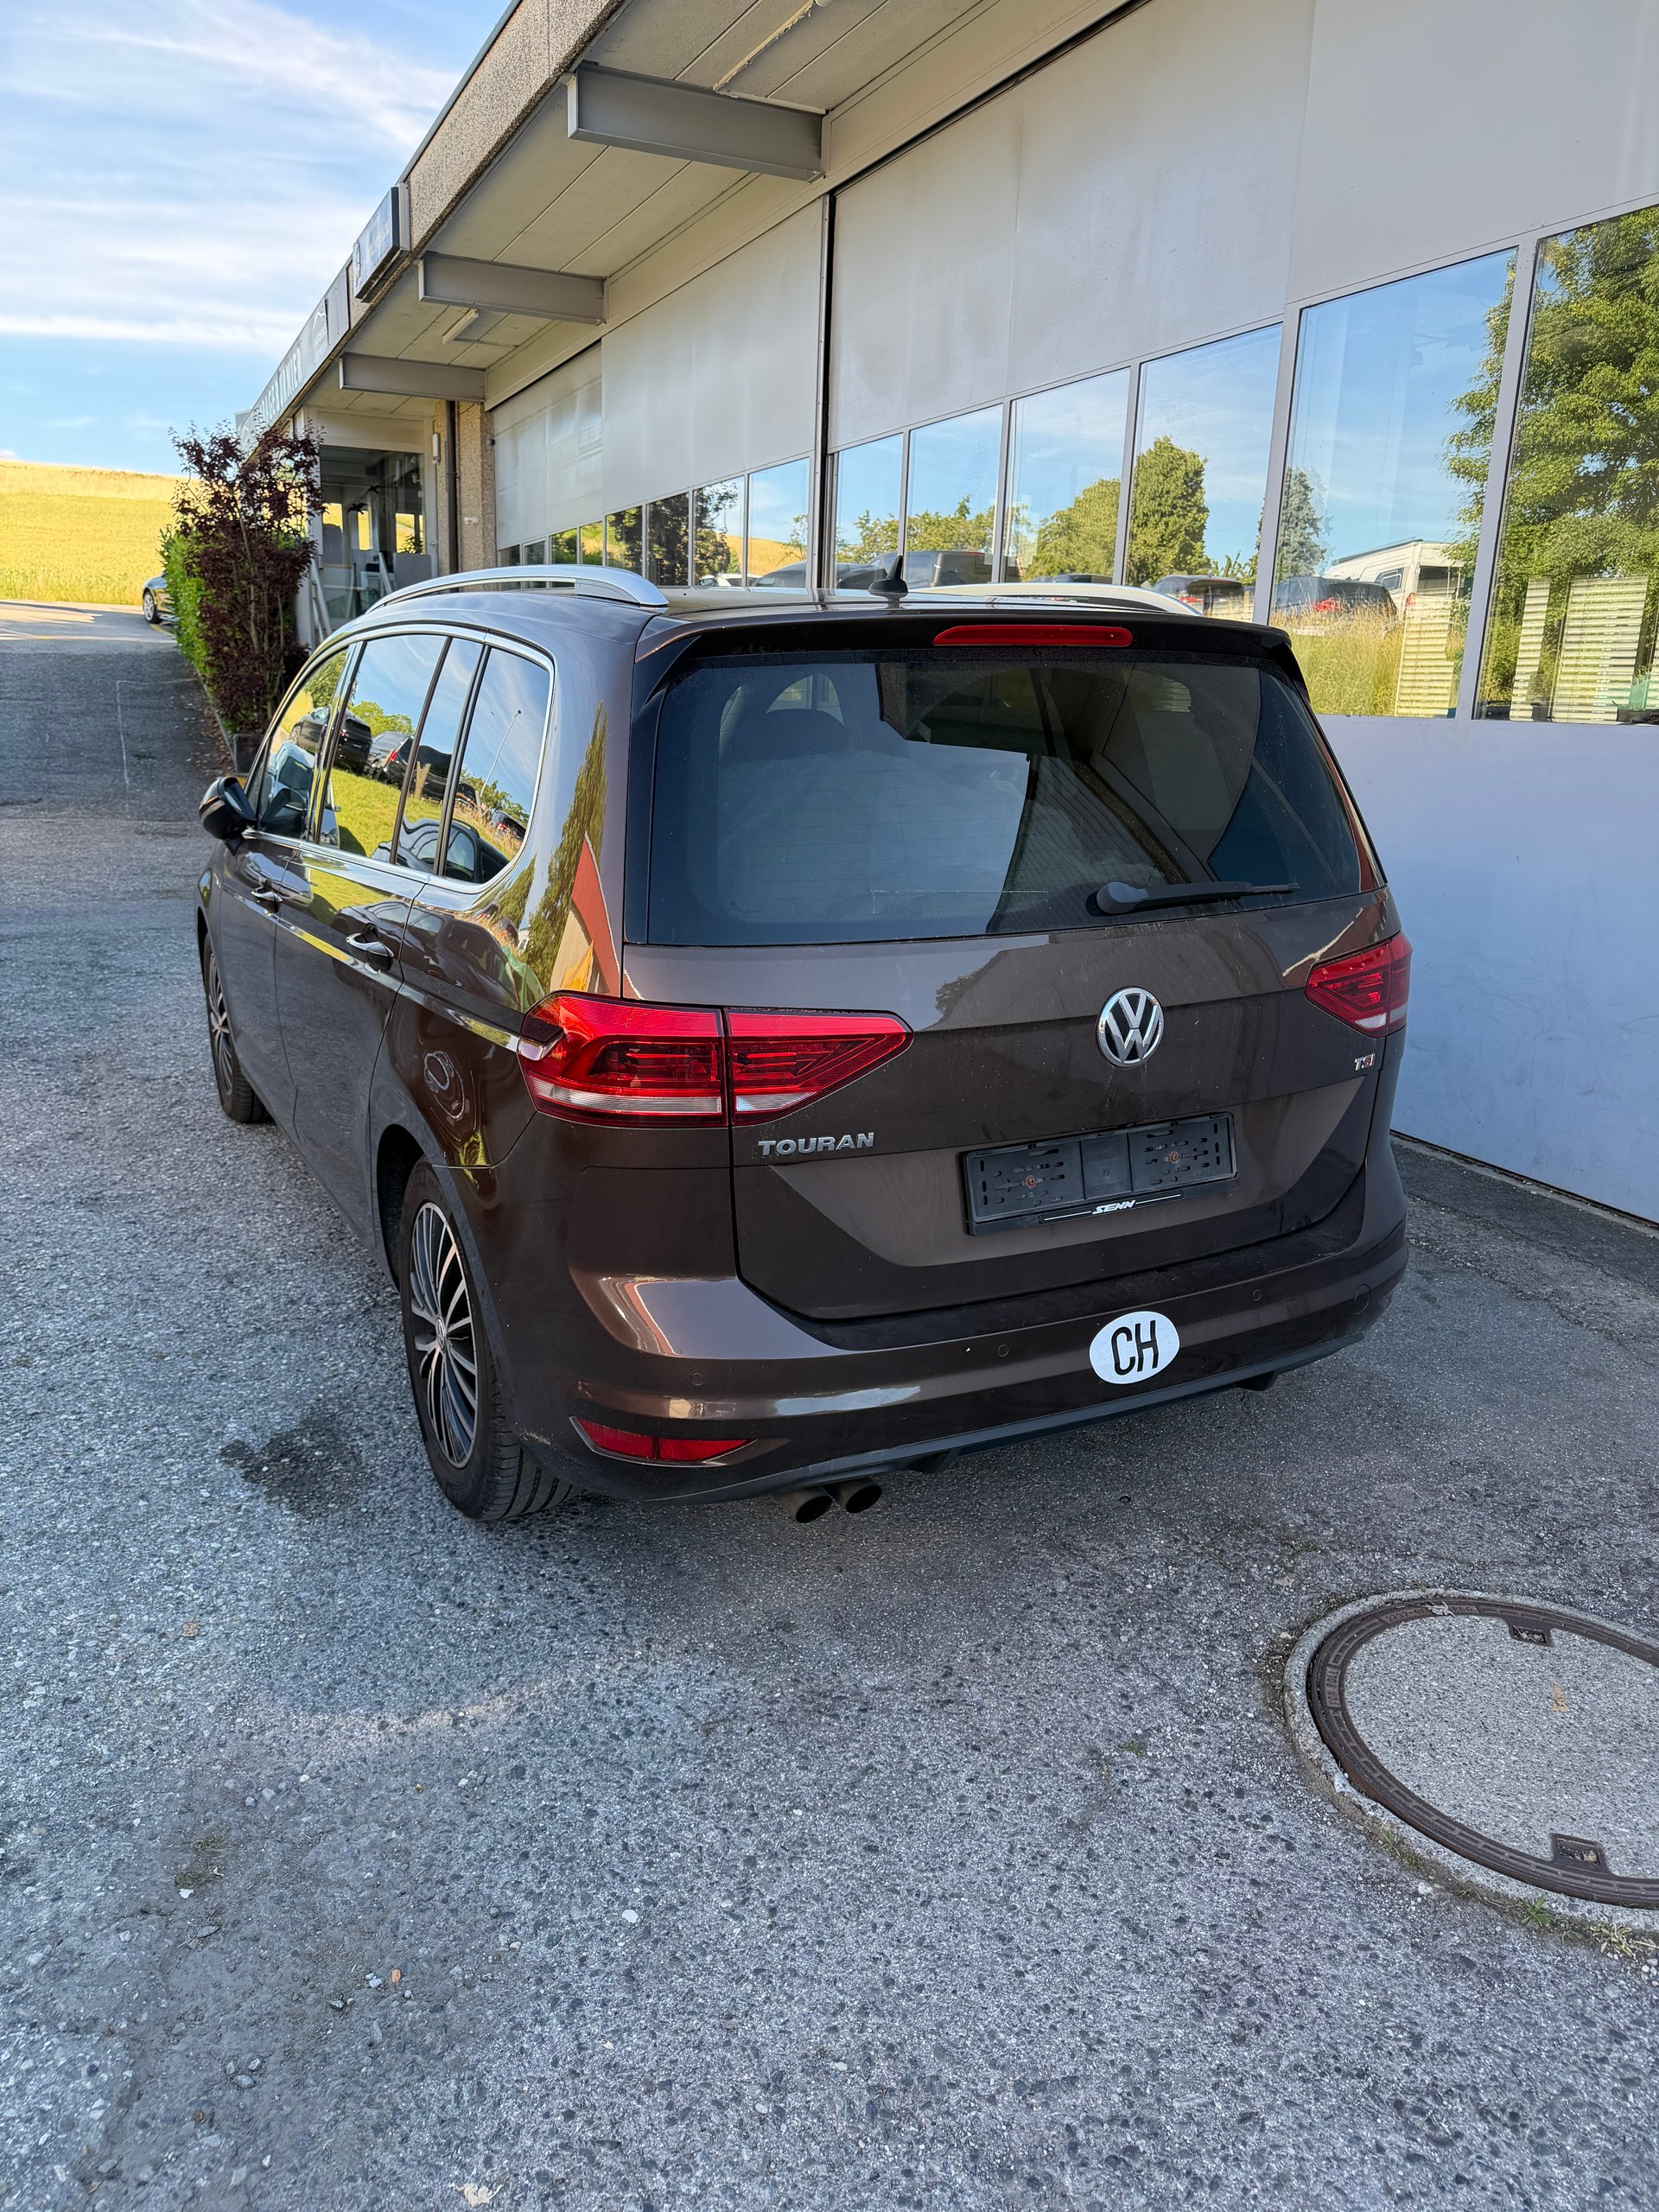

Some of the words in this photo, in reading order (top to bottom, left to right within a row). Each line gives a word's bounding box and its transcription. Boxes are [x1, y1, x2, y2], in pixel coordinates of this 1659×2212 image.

[1103, 990, 1160, 1064] VW
[1354, 1053, 1376, 1071] TSI
[758, 1132, 874, 1156] TOURAN
[1092, 1200, 1136, 1215] SENN
[1111, 1319, 1159, 1376] CH
